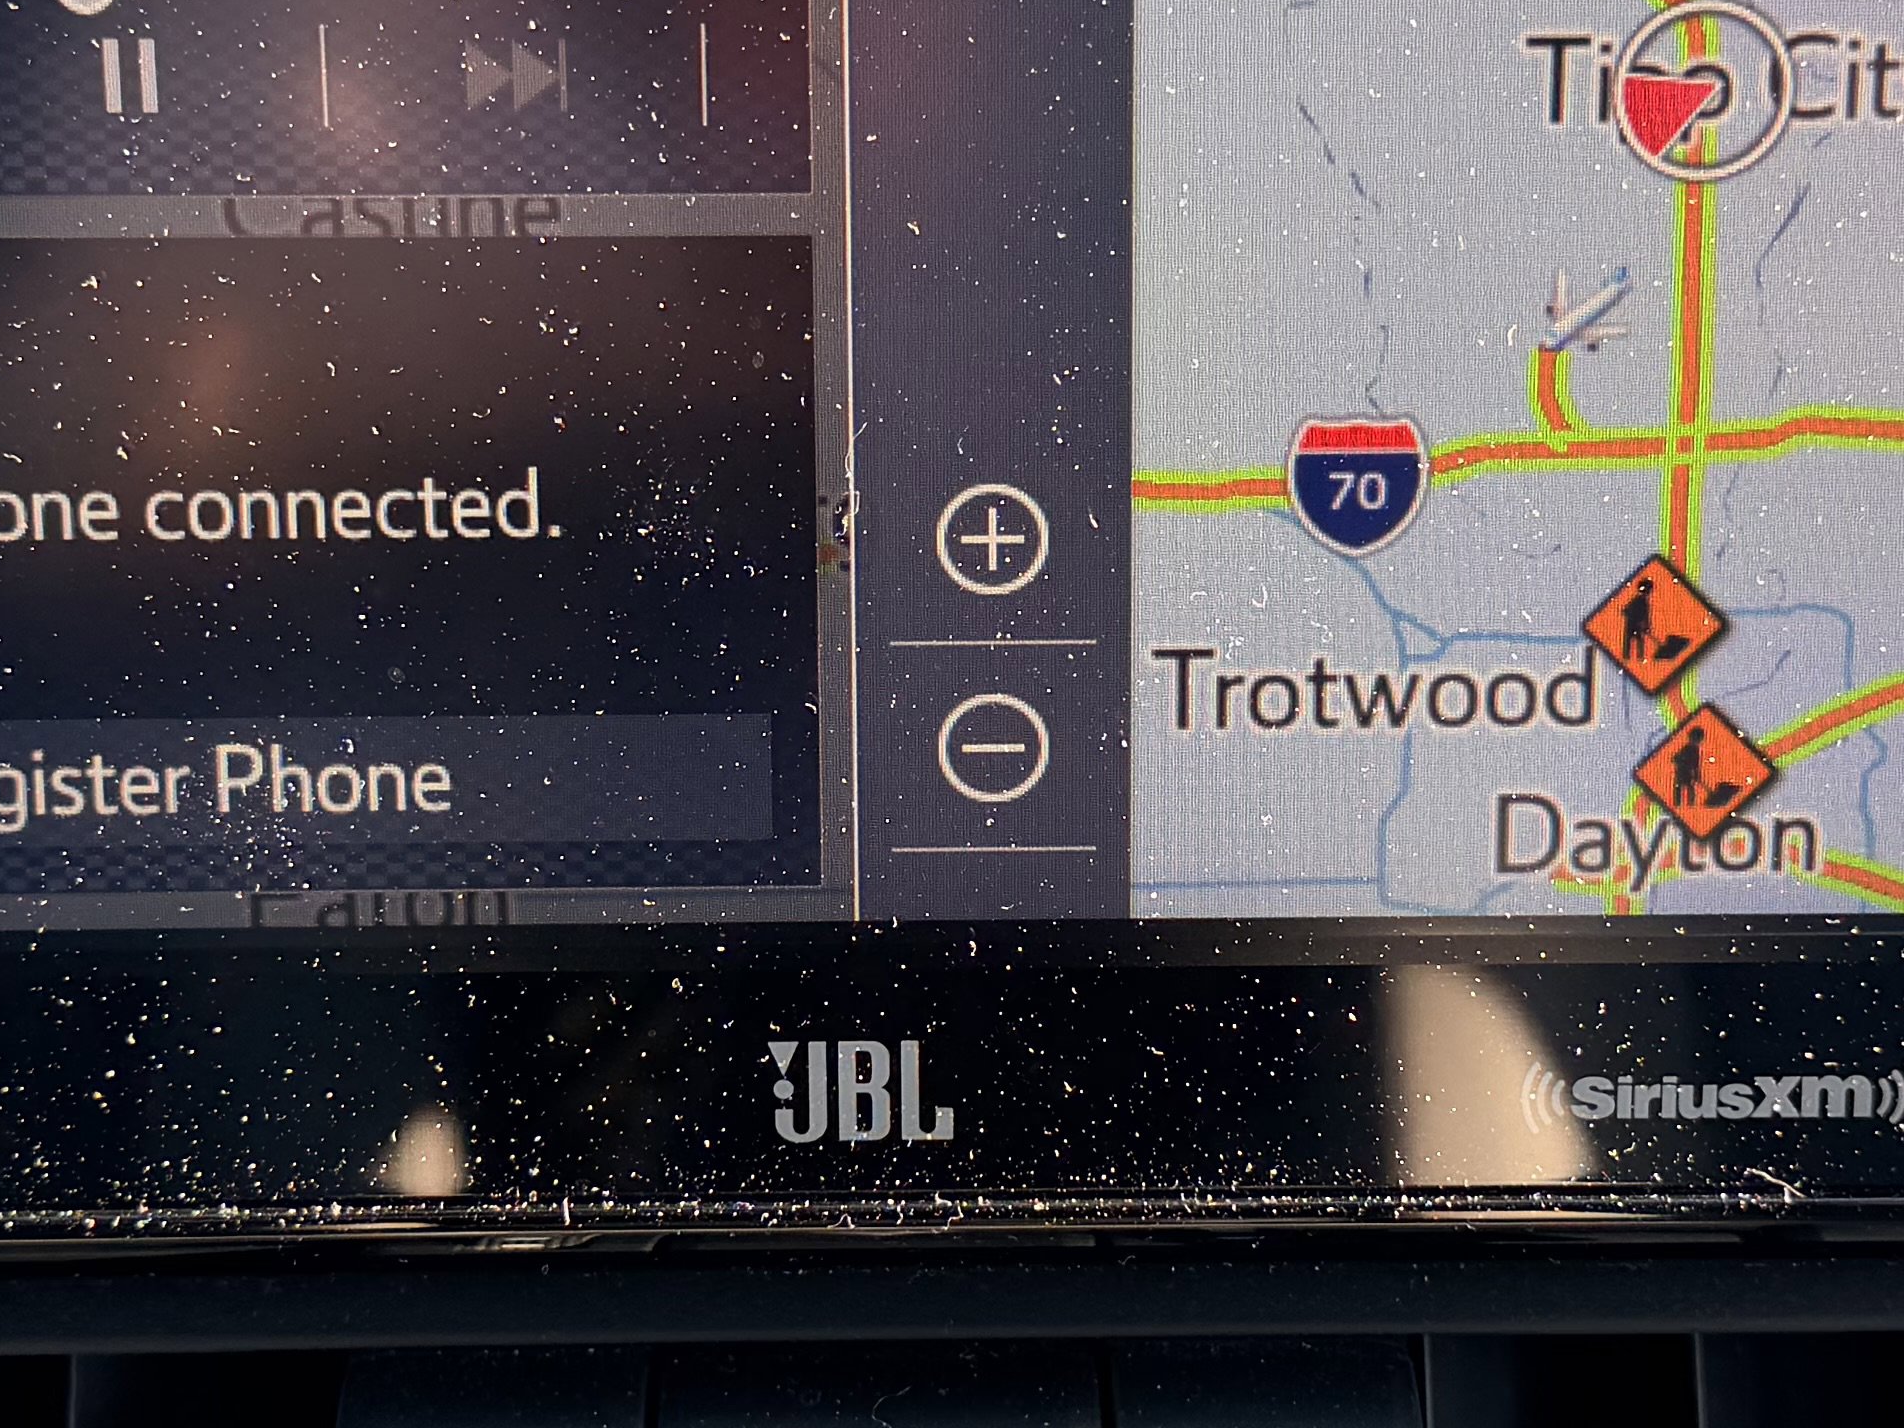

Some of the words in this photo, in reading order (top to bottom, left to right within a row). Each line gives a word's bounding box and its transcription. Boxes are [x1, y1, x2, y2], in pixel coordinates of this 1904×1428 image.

[144, 465, 563, 541] connected.
[1327, 472, 1389, 512] 70
[1152, 645, 1600, 730] Trotwood
[212, 741, 453, 815] Phone
[768, 1040, 954, 1143] JBL
